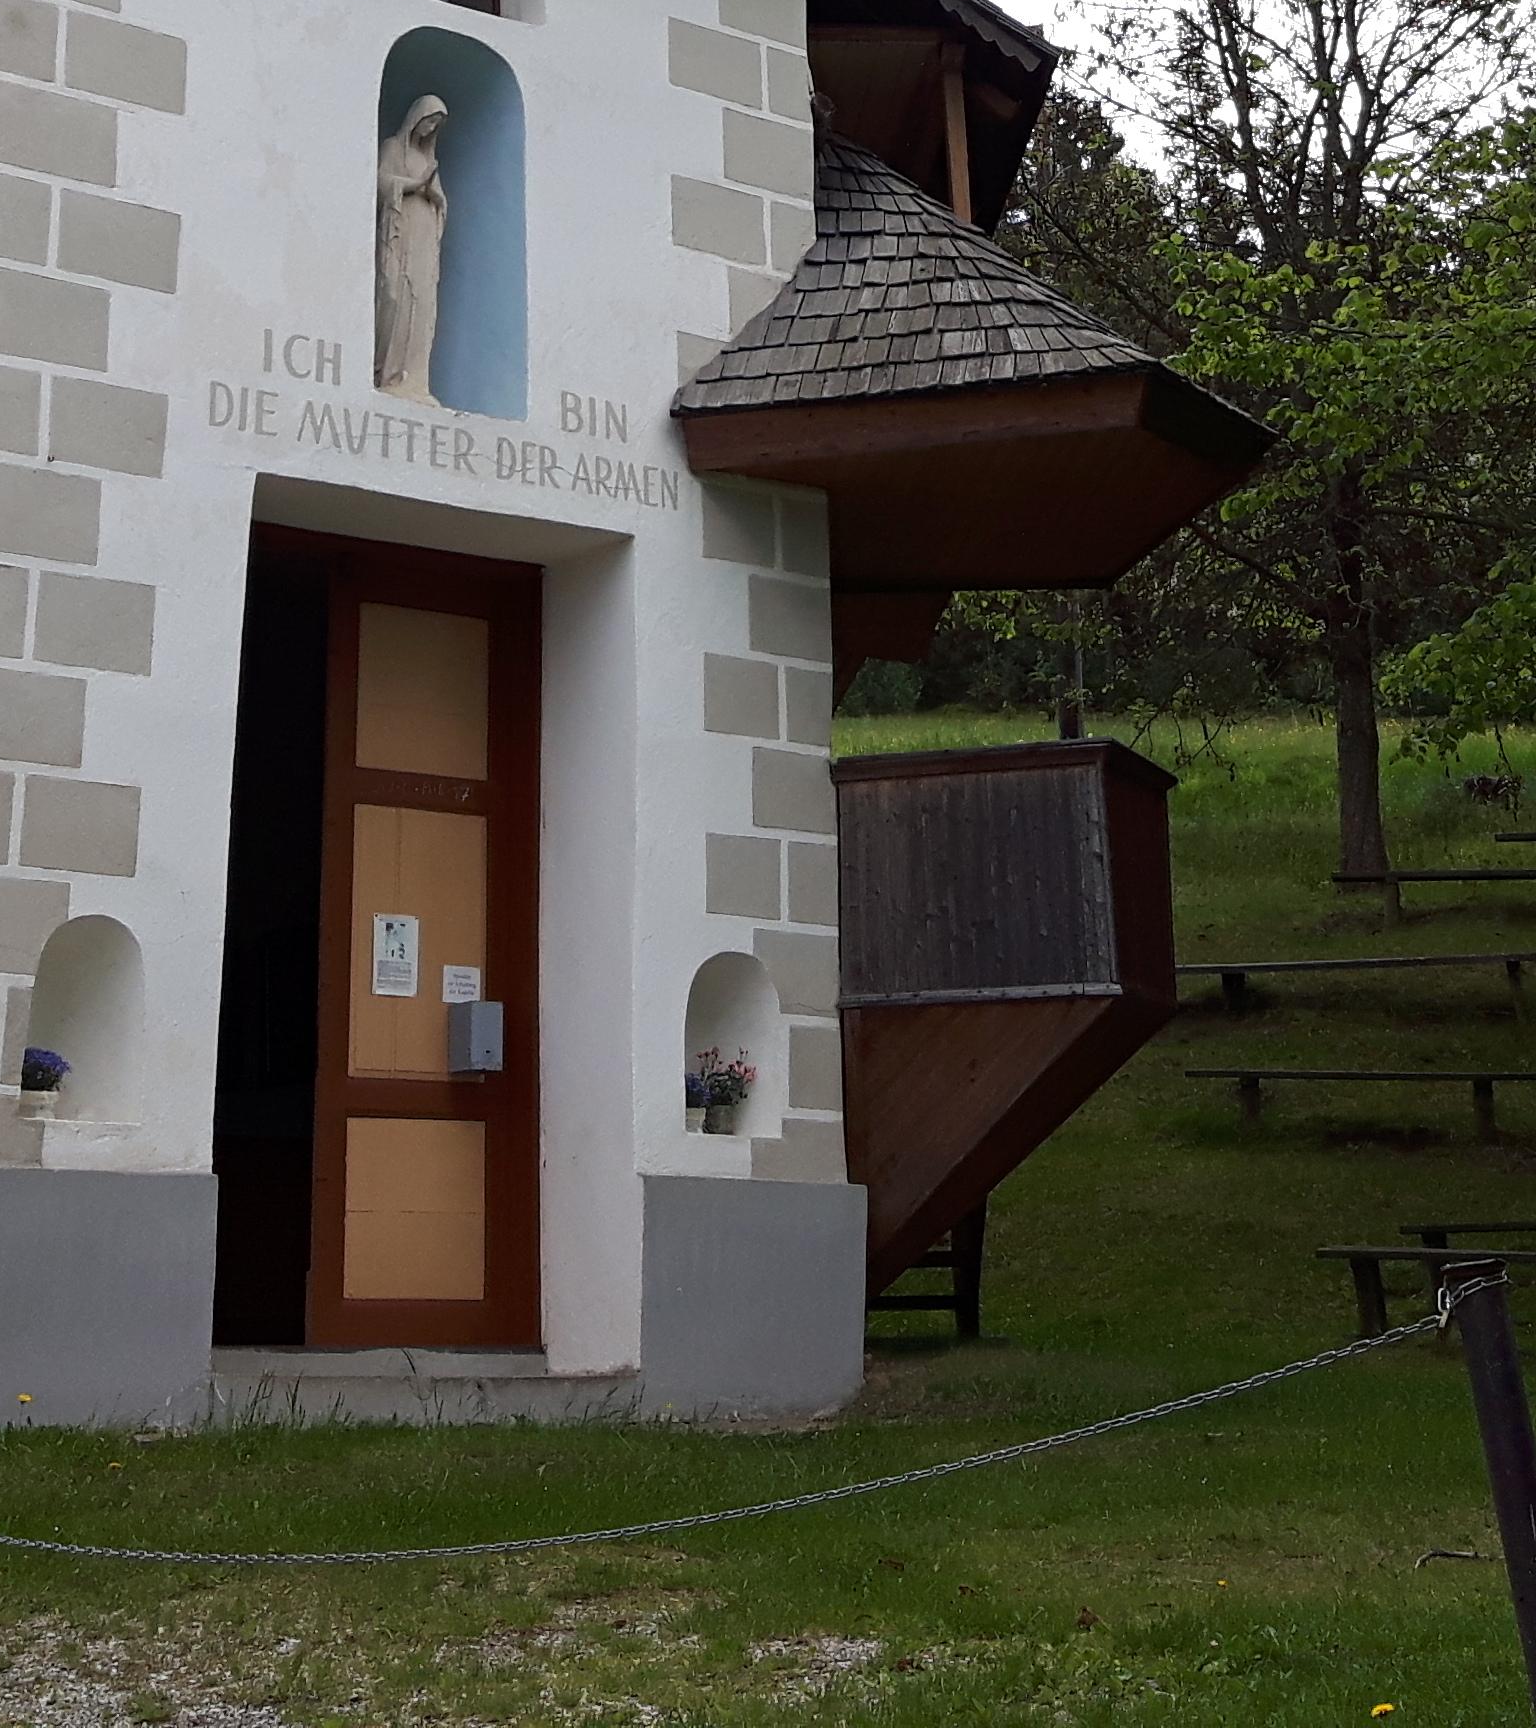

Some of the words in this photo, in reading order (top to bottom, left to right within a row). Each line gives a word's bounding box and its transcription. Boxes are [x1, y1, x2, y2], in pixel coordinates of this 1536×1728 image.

[208, 379, 280, 438] DIE
[296, 398, 479, 476] MUTTER
[495, 435, 561, 491] DER
[570, 452, 680, 512] ARMEN
[263, 327, 344, 386] ICH
[559, 389, 629, 444] BIN
